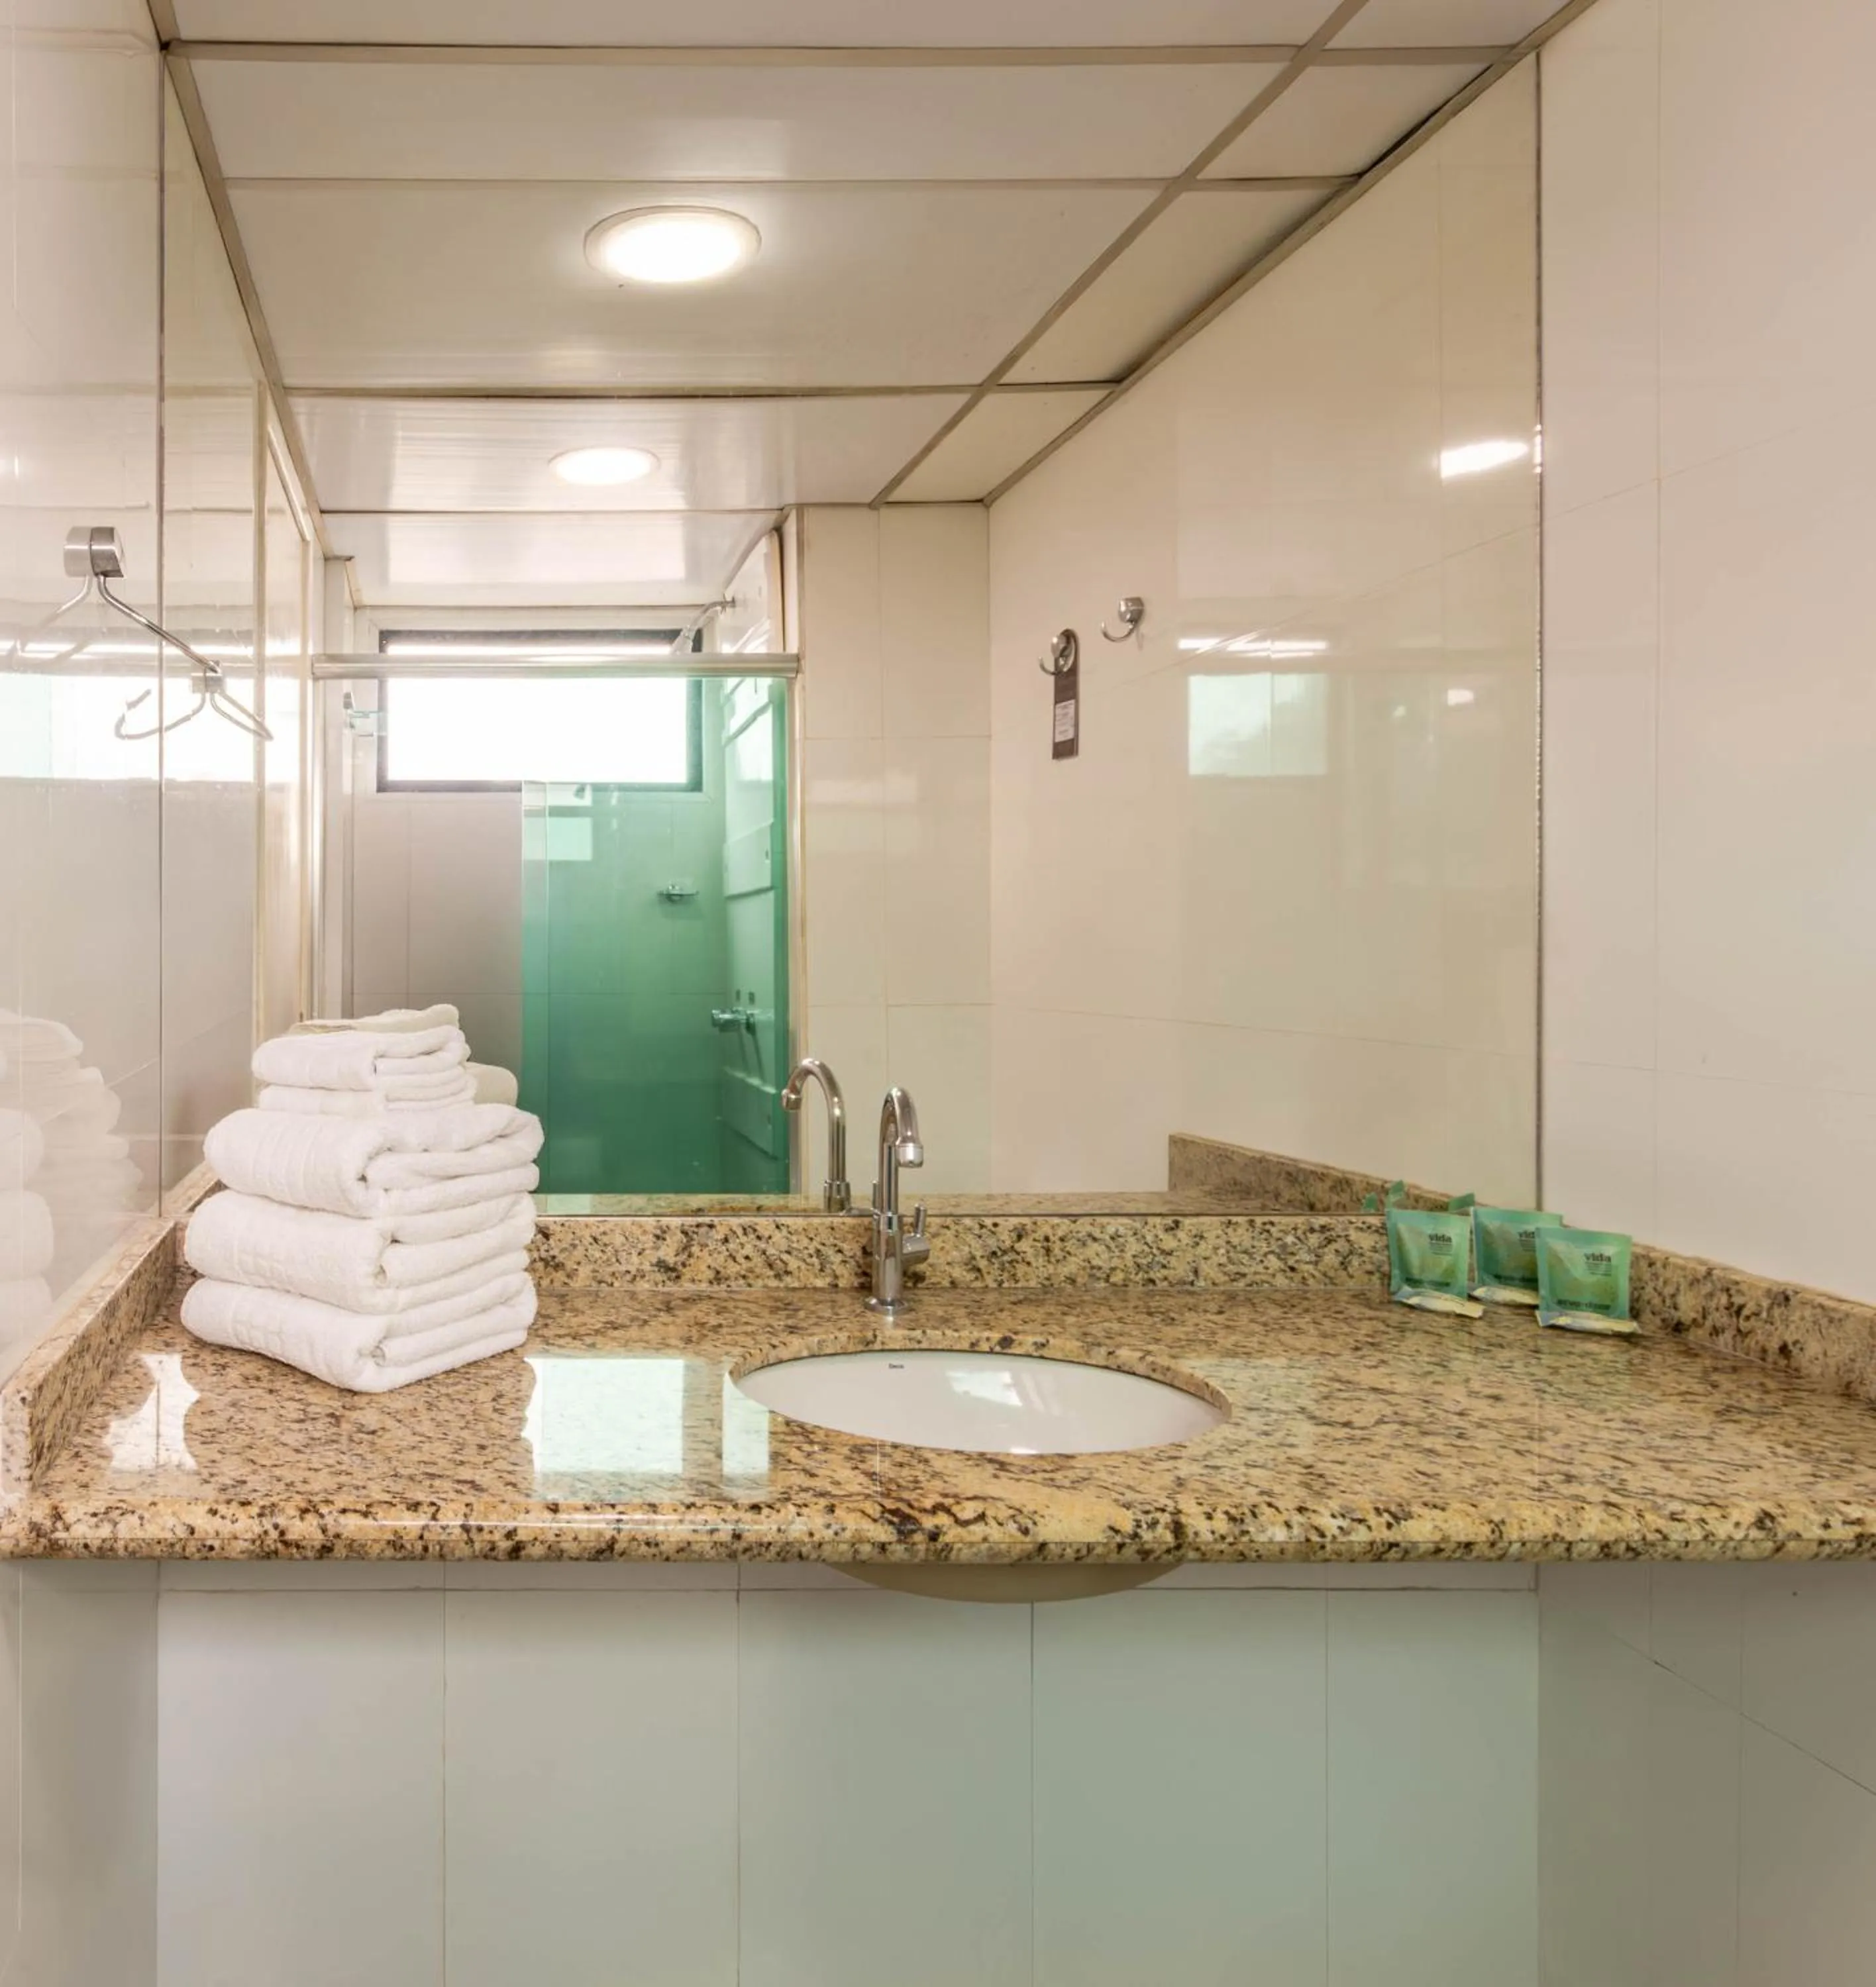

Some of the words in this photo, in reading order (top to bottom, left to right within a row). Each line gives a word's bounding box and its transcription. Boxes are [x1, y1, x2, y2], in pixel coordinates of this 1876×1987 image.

[1428, 1233, 1453, 1243] vida
[1517, 1230, 1536, 1239] vid
[1584, 1252, 1612, 1263] vida
